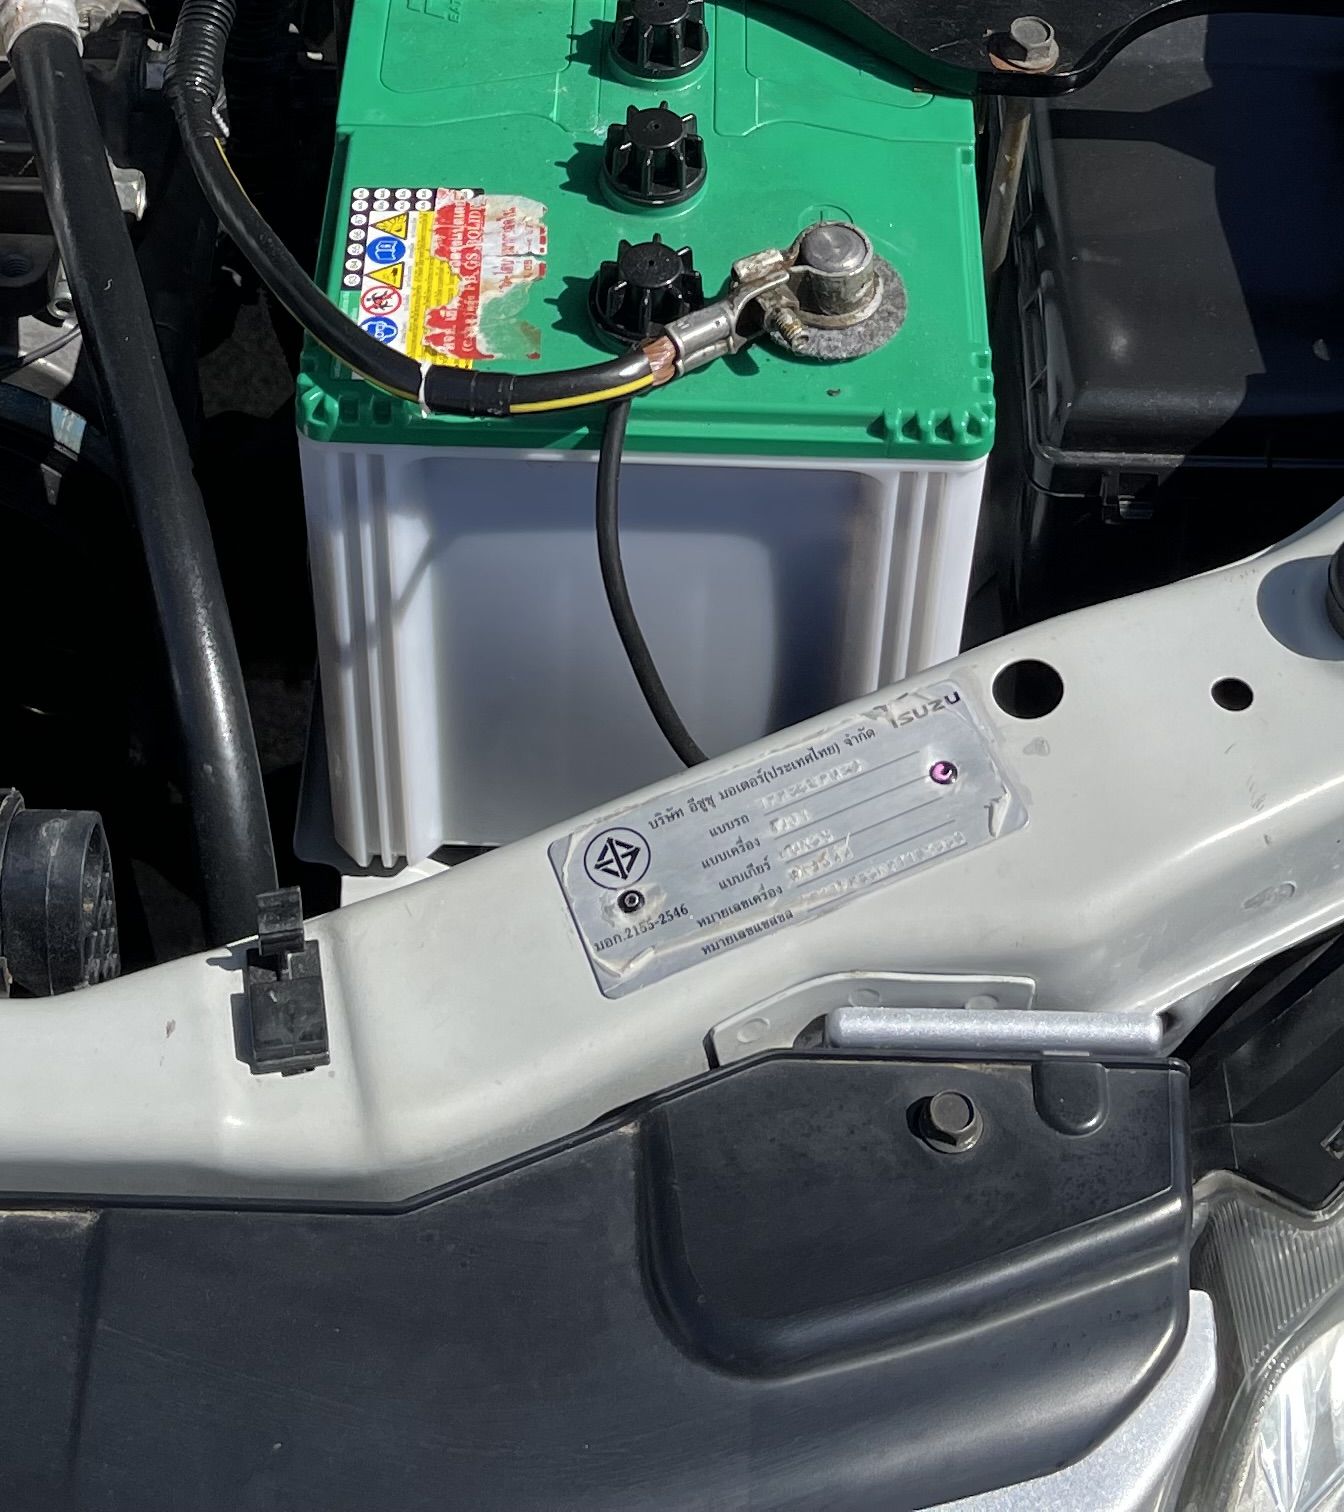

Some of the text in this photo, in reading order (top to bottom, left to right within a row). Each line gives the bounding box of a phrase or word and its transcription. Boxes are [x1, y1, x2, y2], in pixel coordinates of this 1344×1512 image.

[889, 690, 962, 730] ISUZU
[647, 805, 686, 831] บริษัท
[718, 743, 842, 803] มอเตอร์(ประเทศไทย)
[843, 725, 877, 748] จำกัด
[708, 813, 751, 838] แบบรถ
[701, 836, 762, 871] แบบเครื่อง
[718, 857, 773, 891] แบบเกียร์
[696, 882, 785, 929] หมายเลขเครื่อง
